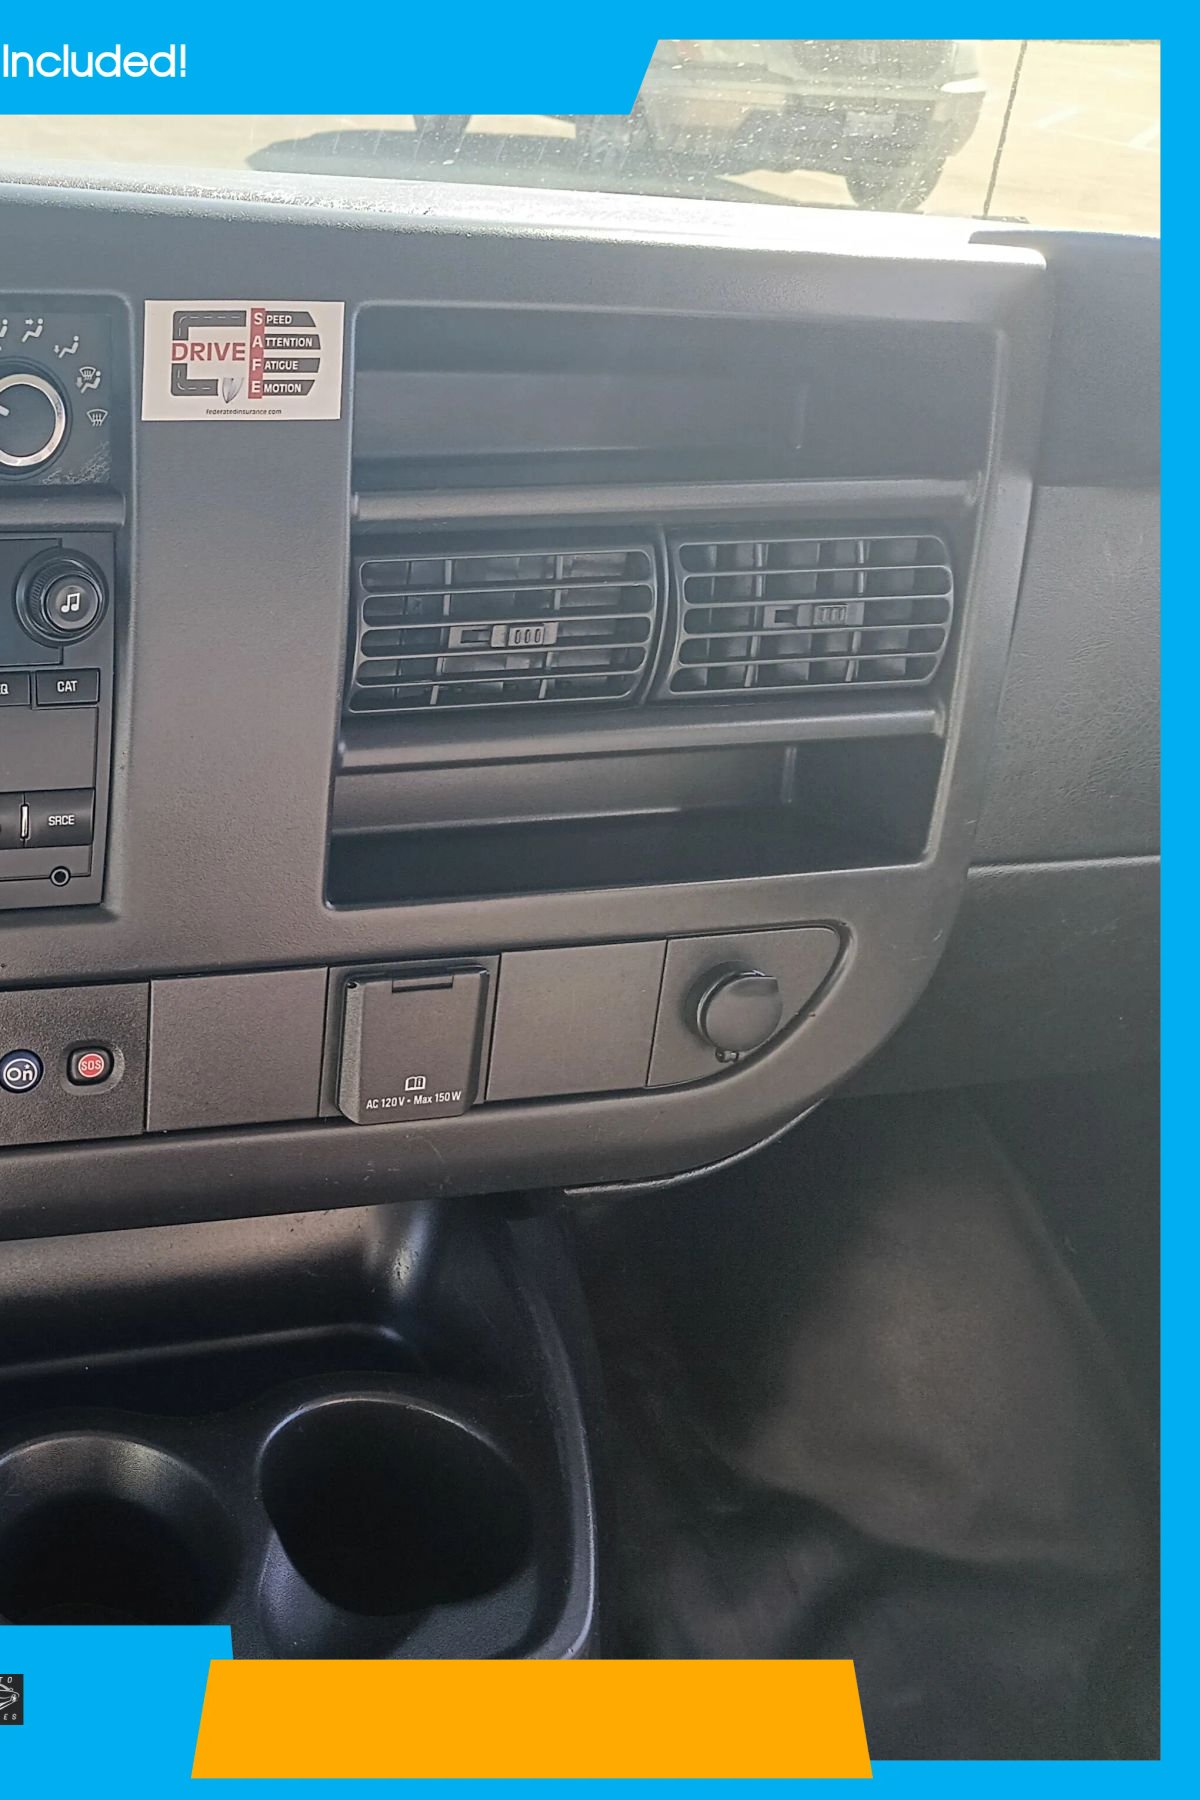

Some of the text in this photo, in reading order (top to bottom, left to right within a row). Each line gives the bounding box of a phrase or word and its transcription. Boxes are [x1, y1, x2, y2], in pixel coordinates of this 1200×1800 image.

[171, 342, 246, 361] DRIVE
[56, 680, 78, 693] CAT
[48, 814, 75, 826] SRCE
[80, 1059, 102, 1071] SOS
[366, 1099, 379, 1110] AC
[414, 1094, 432, 1105] Max
